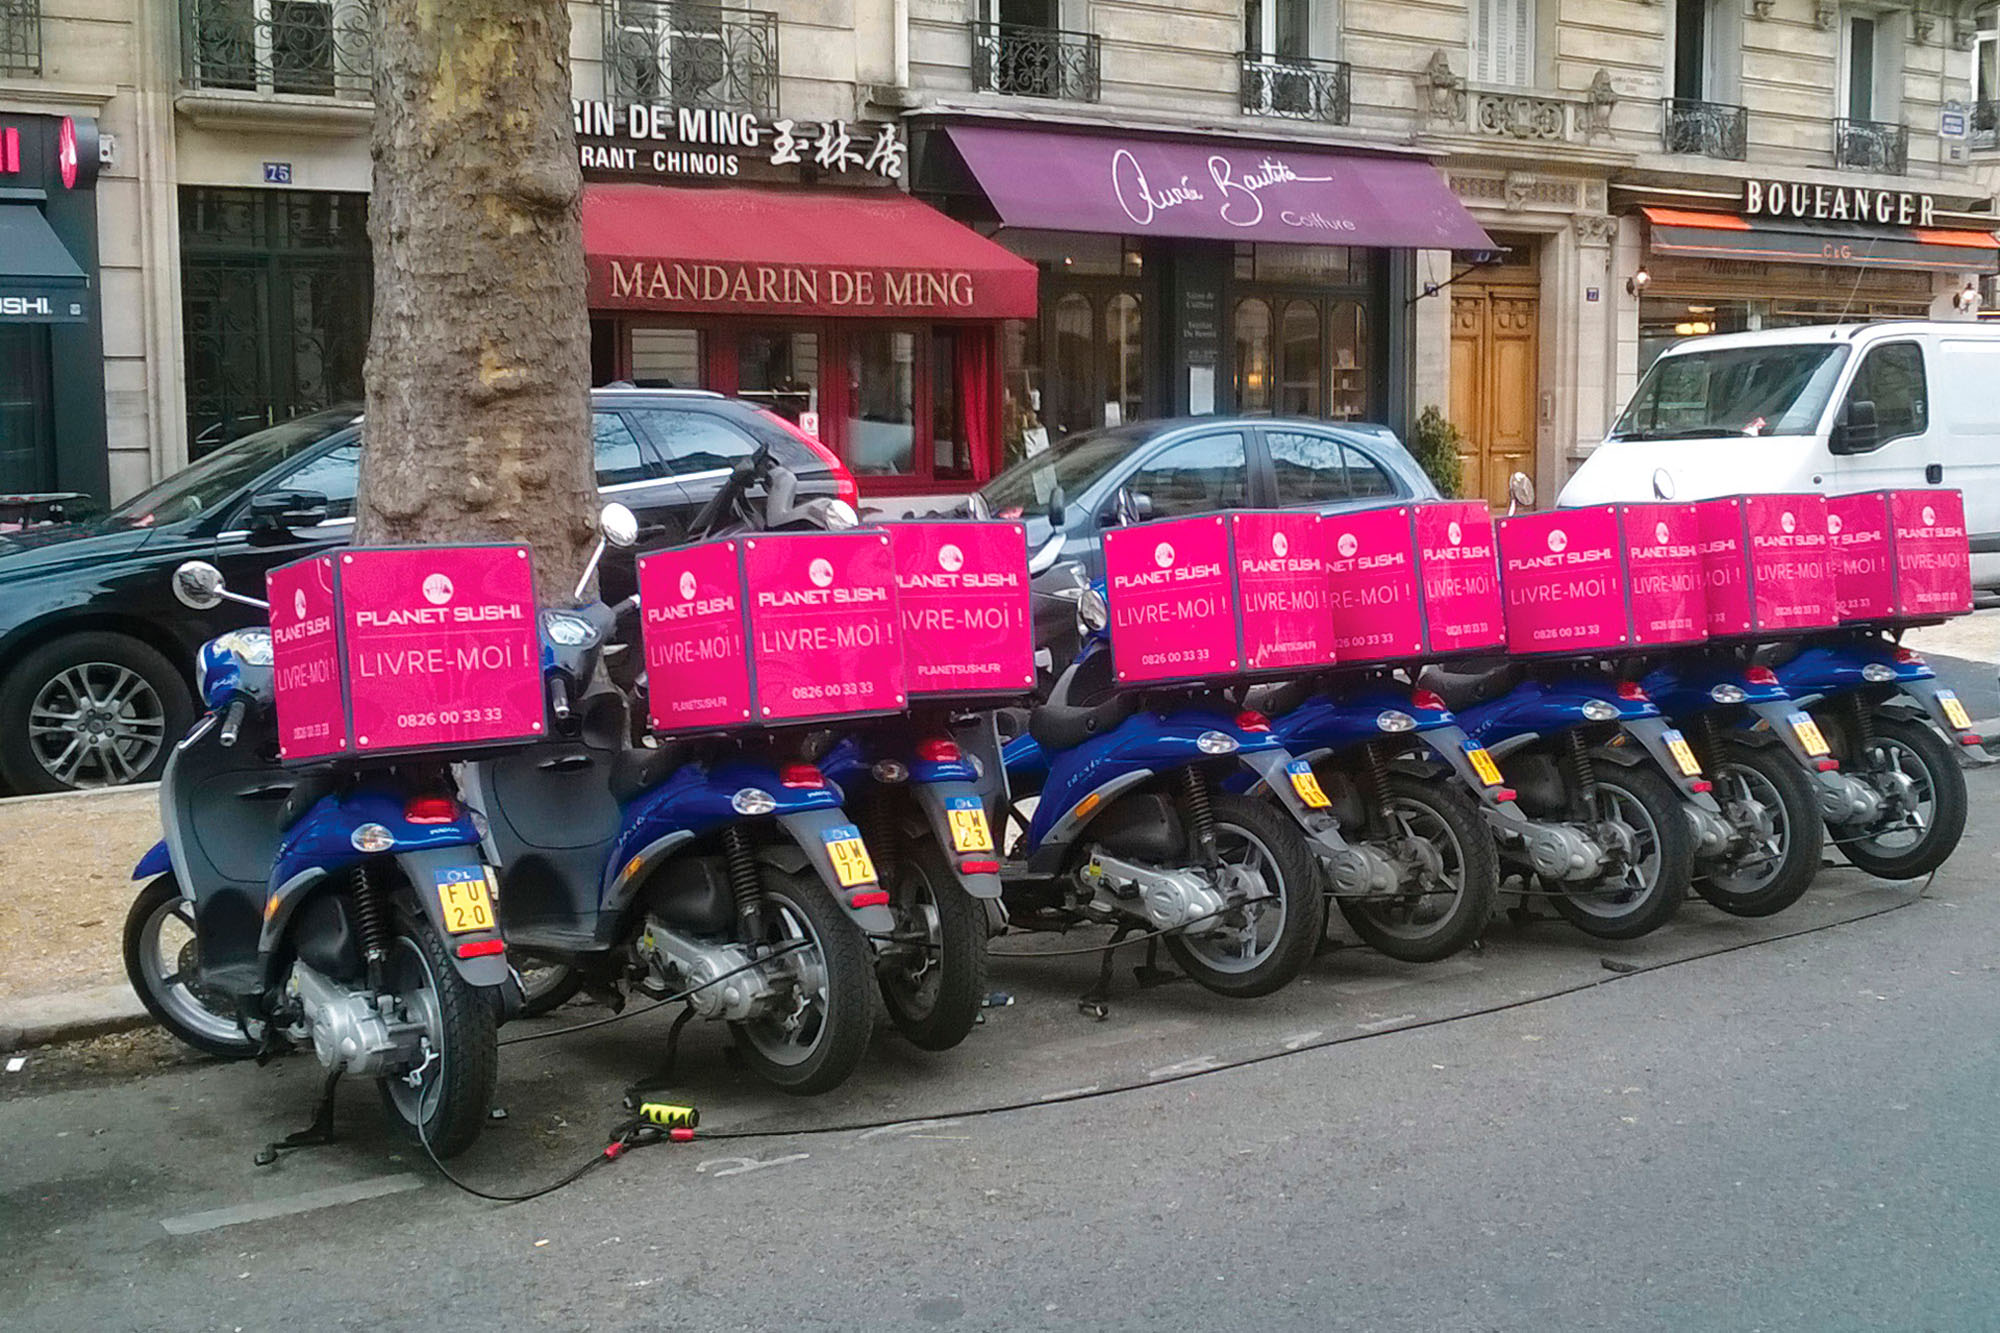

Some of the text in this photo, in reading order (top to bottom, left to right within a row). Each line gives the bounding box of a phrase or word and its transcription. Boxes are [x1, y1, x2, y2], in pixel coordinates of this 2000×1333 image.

[629, 103, 667, 140] DE
[678, 107, 759, 147] MING
[581, 145, 739, 176] RANT CHINOIS
[267, 164, 289, 181] 75
[1747, 180, 1935, 227] BOULANGER
[1280, 211, 1356, 231] Coiffure
[610, 260, 974, 308] MANDARIN DE MING
[0, 297, 49, 314] SHI
[1754, 534, 1826, 547] PLANET SUSHI
[1423, 546, 1491, 561] PLANET SUSHI
[1509, 548, 1612, 571] PLANET SUSHI
[1631, 545, 1697, 559] PLANET SUSHI
[1114, 563, 1220, 588] PLANET SUSHI
[1242, 558, 1320, 573] PLANET SUSHI
[758, 587, 885, 607] PLANET SUSHI
[356, 604, 521, 627] PLANET SUSHI
[648, 596, 735, 622] PLANET SUSHI
[274, 616, 331, 644] PLANET SUSHI
[1533, 624, 1600, 640] 0826 00 33 33
[1142, 649, 1209, 665] 0826 00 33 33
[792, 682, 874, 699] 0826 00 33 33
[397, 707, 503, 728] 0826 00 33 33
[955, 811, 982, 828] CW
[834, 842, 862, 861] DW
[841, 862, 871, 880] 72
[446, 882, 480, 904] FU
[453, 905, 486, 928] 20
